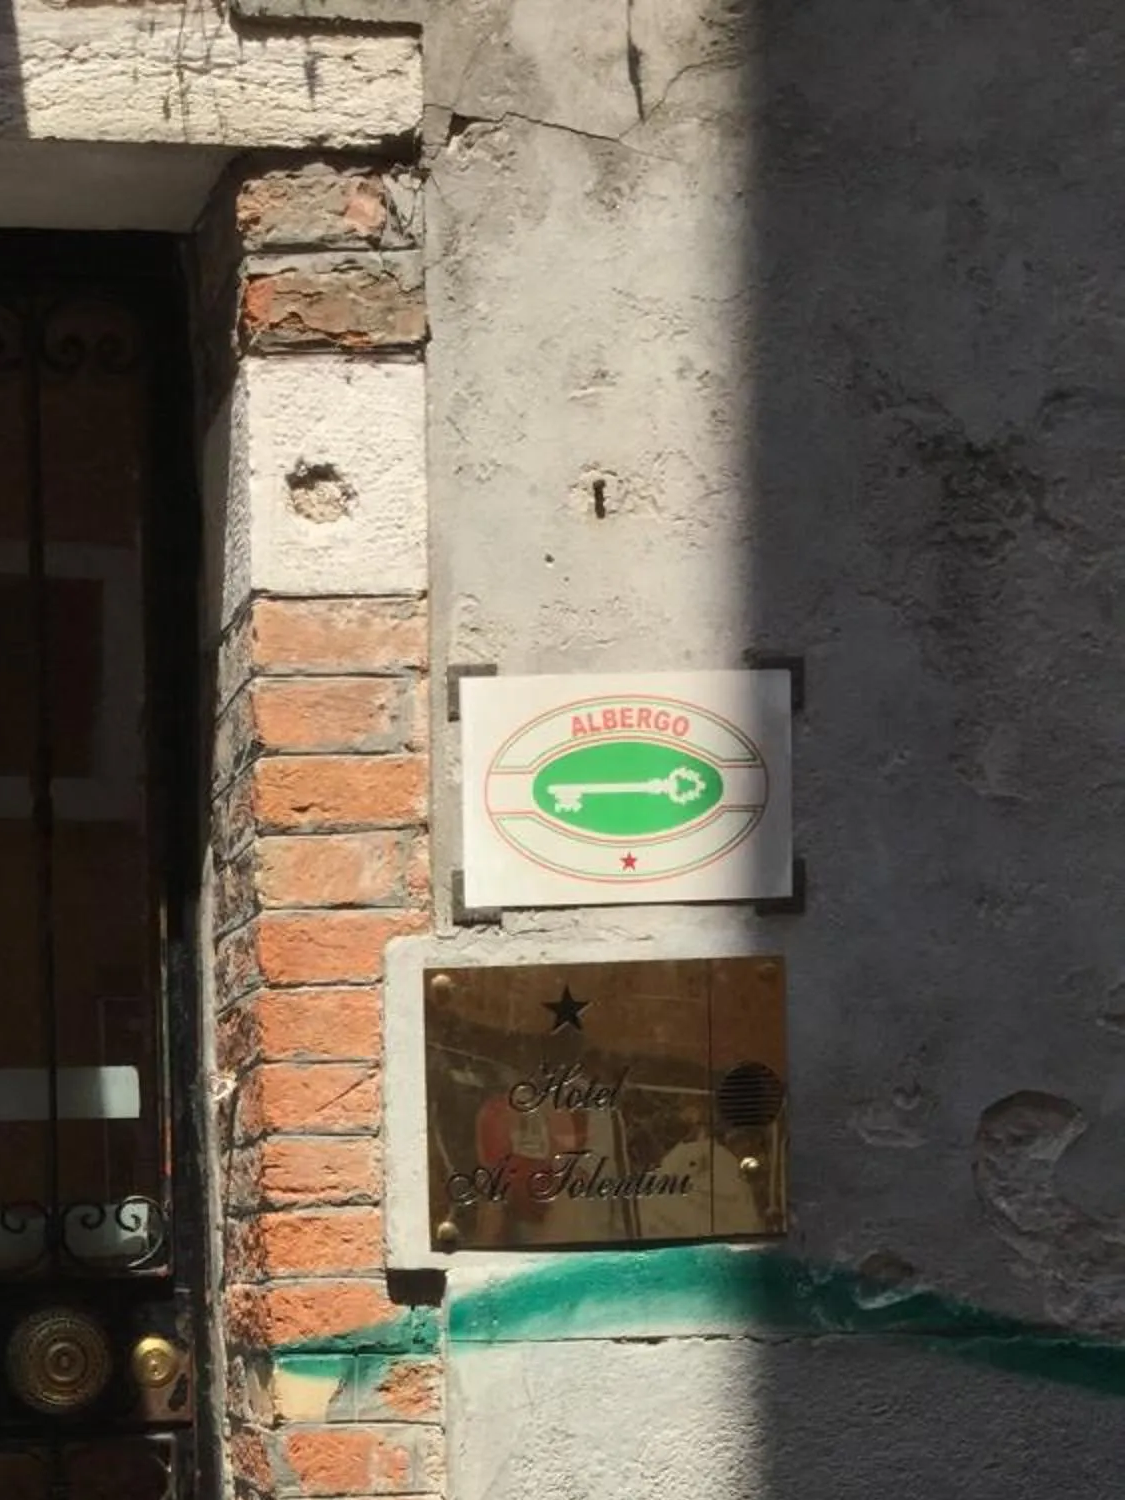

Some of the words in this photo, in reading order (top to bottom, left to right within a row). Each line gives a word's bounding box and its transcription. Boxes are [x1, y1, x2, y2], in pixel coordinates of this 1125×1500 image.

[570, 708, 690, 739] ALBERGO
[508, 1060, 629, 1113] Hotel
[445, 1156, 511, 1208] Ai
[530, 1146, 694, 1204] Tolentini
